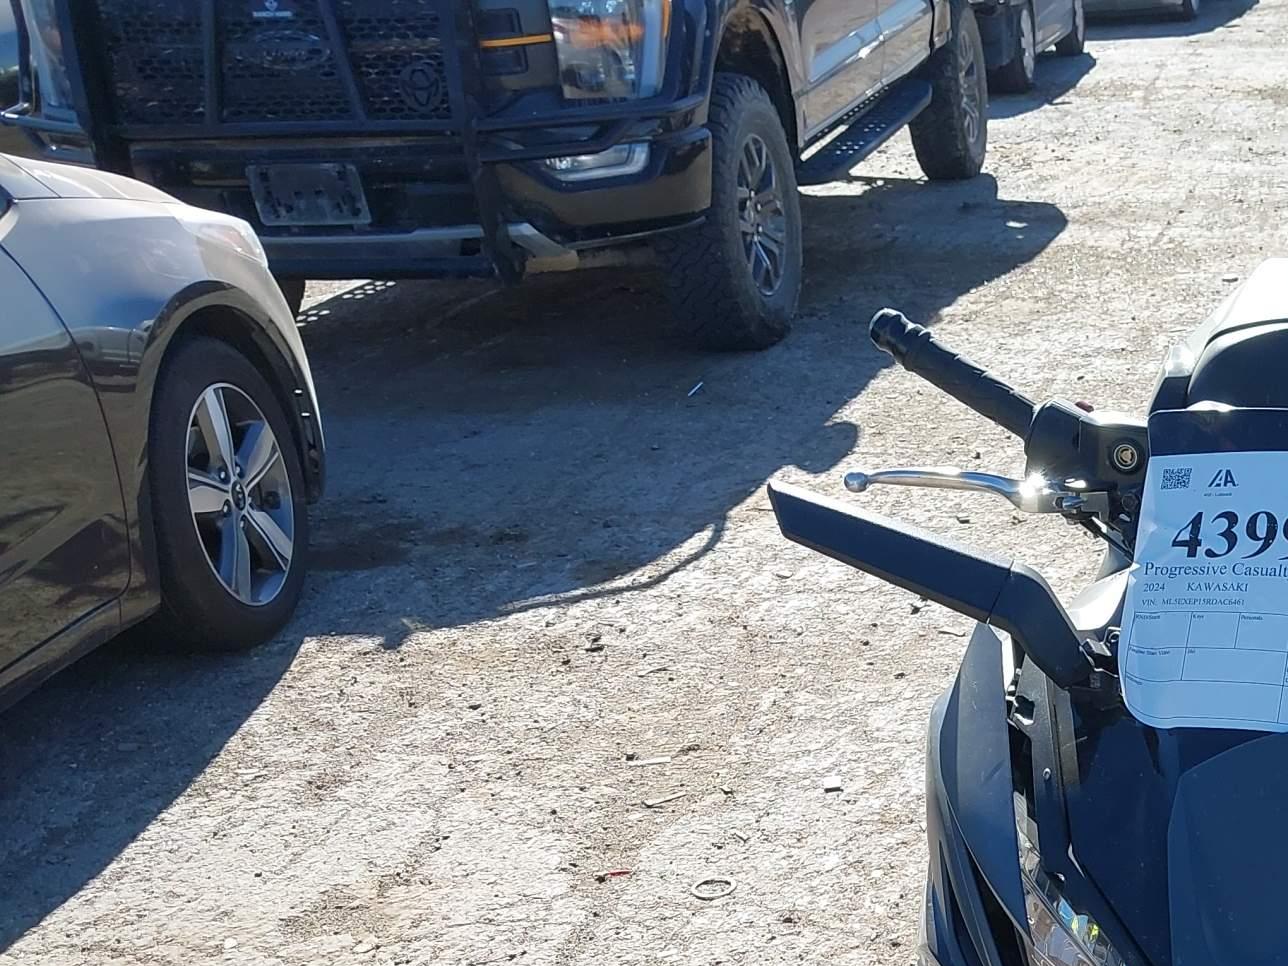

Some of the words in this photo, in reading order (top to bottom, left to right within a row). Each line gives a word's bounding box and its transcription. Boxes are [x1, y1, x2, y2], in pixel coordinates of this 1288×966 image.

[1143, 561, 1227, 579] Progressive
[1143, 583, 1166, 592] 2024
[1186, 582, 1249, 592] KAWASAKI
